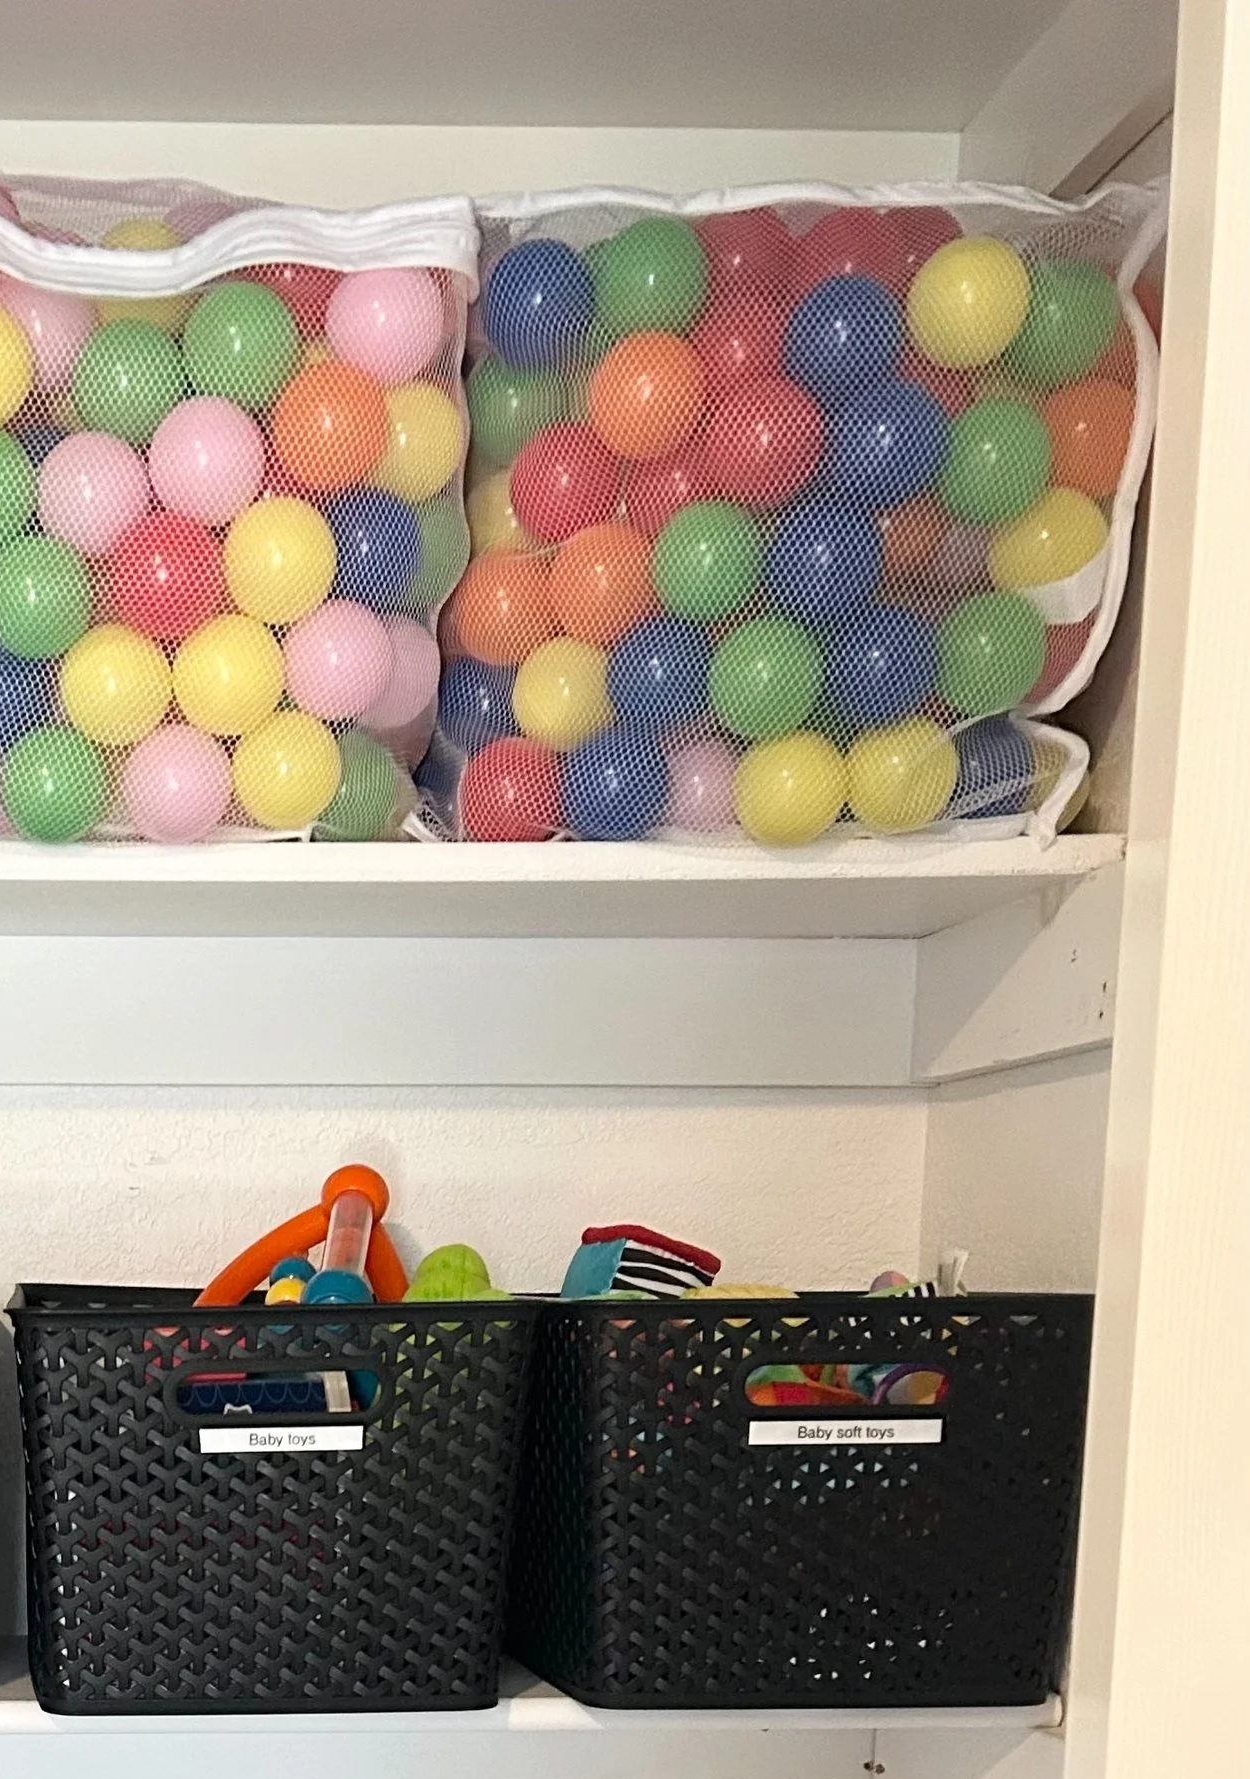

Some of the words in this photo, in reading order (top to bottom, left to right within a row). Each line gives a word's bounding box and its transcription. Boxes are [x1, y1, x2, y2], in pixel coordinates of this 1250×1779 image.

[249, 1432, 283, 1447] Baby
[288, 1432, 316, 1446] toys
[797, 1425, 833, 1440] Baby
[837, 1424, 861, 1438] soft
[866, 1425, 895, 1440] toys
